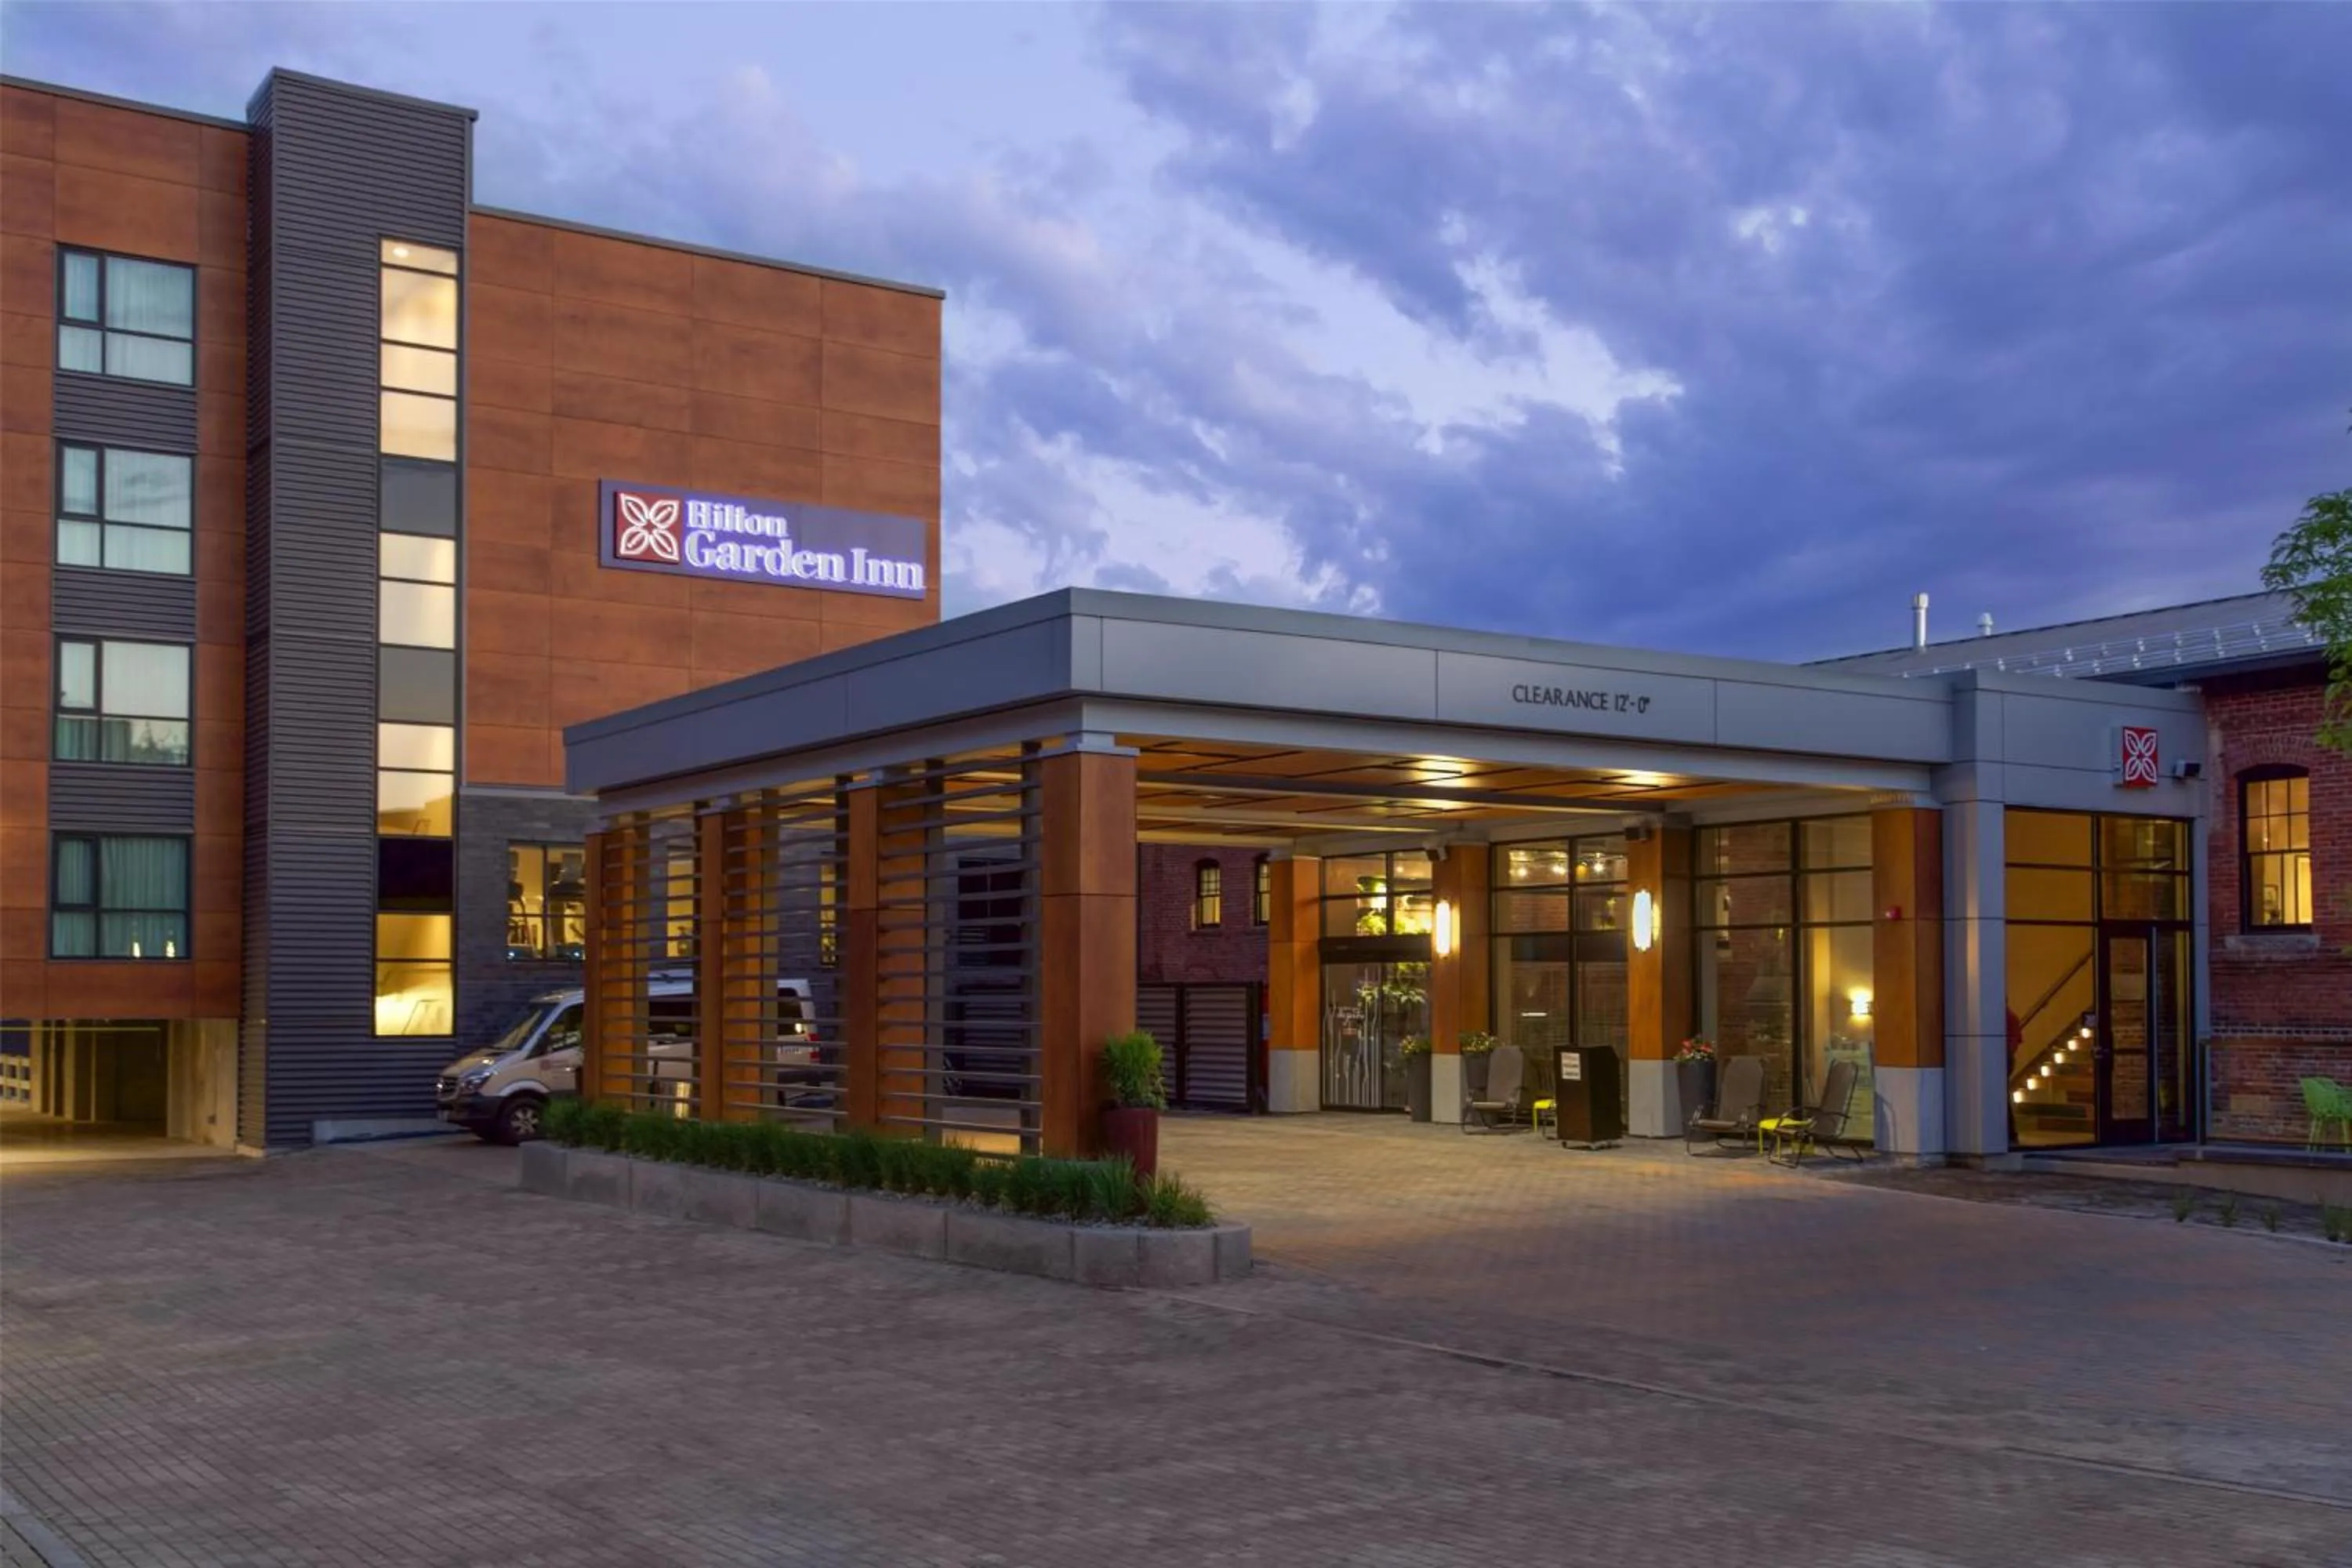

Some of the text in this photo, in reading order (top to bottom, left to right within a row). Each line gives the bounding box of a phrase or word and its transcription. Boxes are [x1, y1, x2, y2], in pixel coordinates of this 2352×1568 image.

[687, 499, 789, 538] Hilton
[684, 529, 926, 590] Garden Inn
[1512, 684, 1608, 711] CLEARANCE
